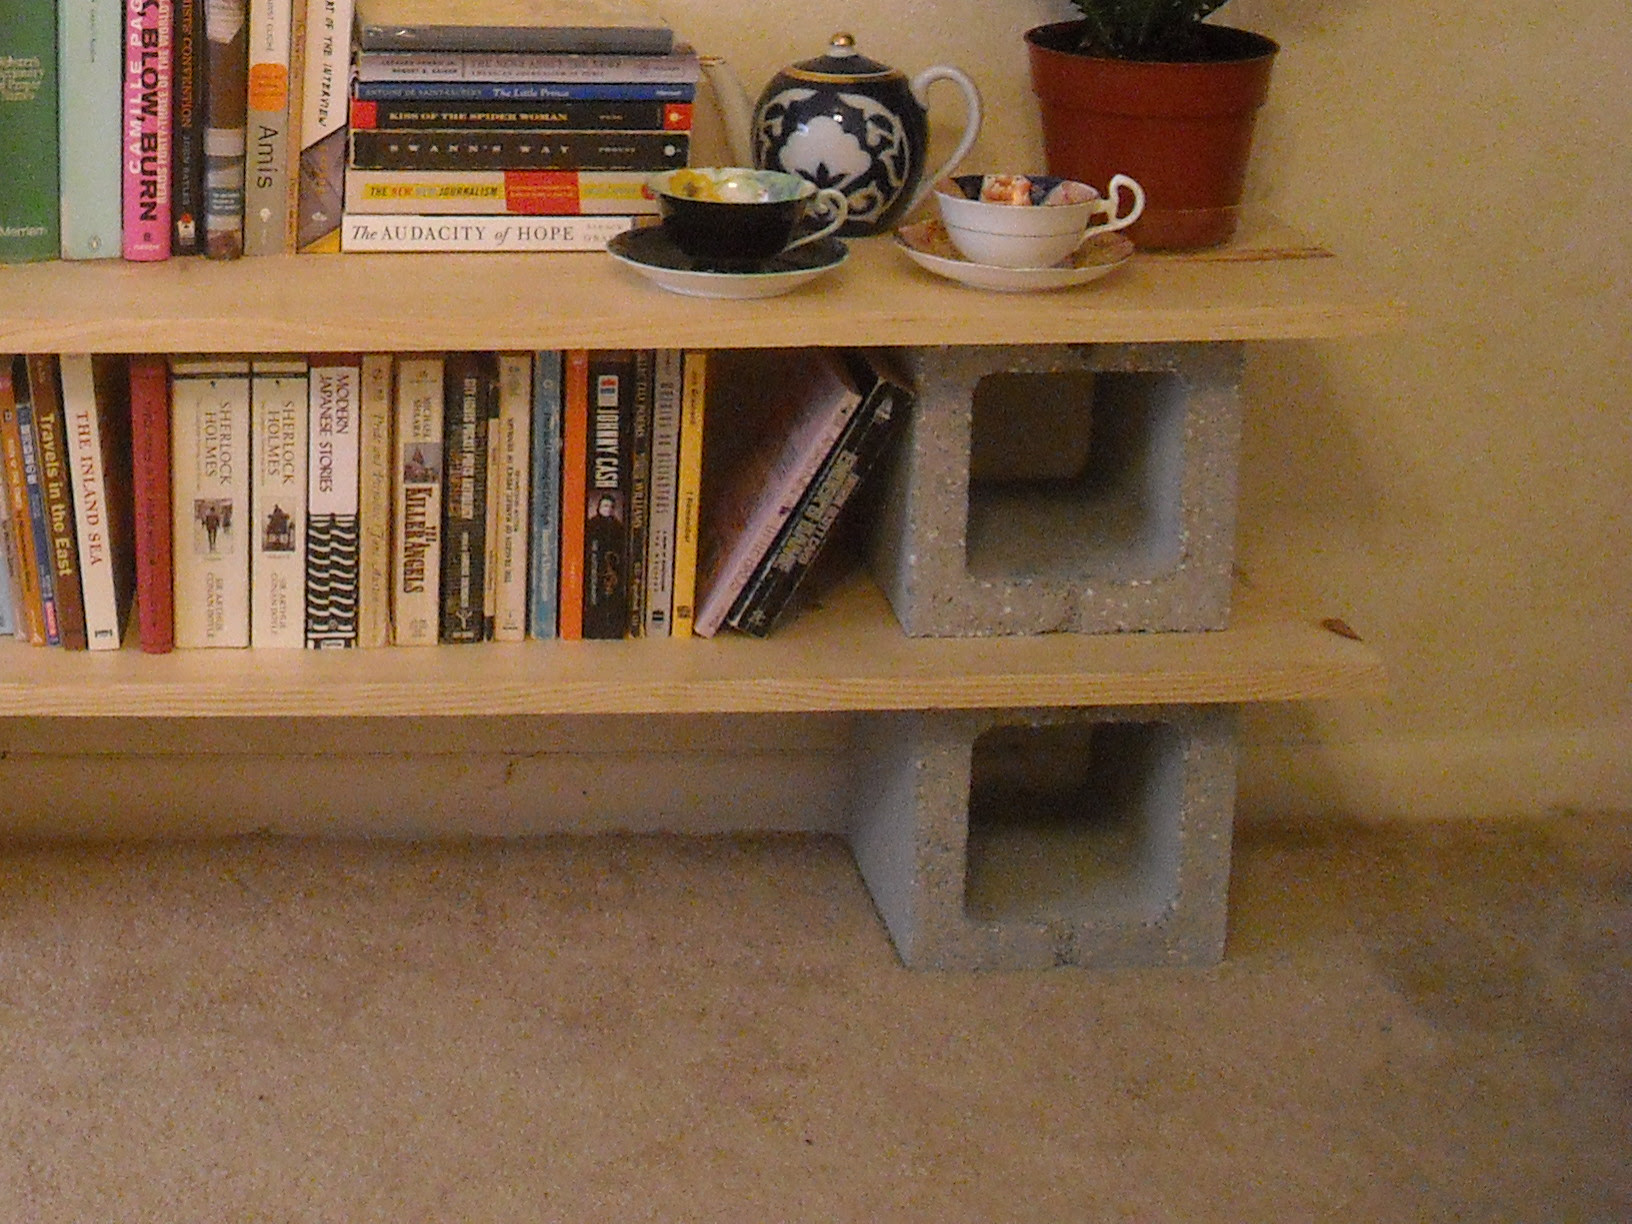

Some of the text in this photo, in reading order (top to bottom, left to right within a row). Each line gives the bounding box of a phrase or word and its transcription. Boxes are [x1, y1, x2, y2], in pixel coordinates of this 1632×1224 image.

[322, 37, 334, 56] THE
[324, 17, 335, 31] OF
[137, 27, 160, 123] BLOW,
[180, 37, 195, 128] CONVENTION
[318, 63, 333, 128] INTERVIEW
[128, 61, 143, 174] CAMILLE
[256, 125, 280, 189] Amis
[441, 112, 467, 122] THE
[469, 112, 517, 122] SPIDER
[139, 132, 159, 222] BURN
[369, 187, 387, 197] THE
[438, 186, 499, 198] JOURNALISM
[351, 225, 378, 240] The
[380, 225, 487, 241] AUDACITY
[494, 226, 512, 246] of
[517, 226, 575, 242] HOPE
[219, 401, 233, 486] SHERLOCK
[267, 410, 281, 476] HOLMES
[282, 400, 296, 485] SHERLOCK
[318, 374, 334, 493] JAPANESE STORIES
[335, 372, 351, 434] MODERN
[204, 411, 218, 477] HOLMES
[594, 408, 620, 489] JOHNNY CASH
[40, 411, 73, 577] Travels in the East
[76, 410, 104, 566] THE INLAND SEA
[402, 486, 434, 594] KILLER ANGELS
